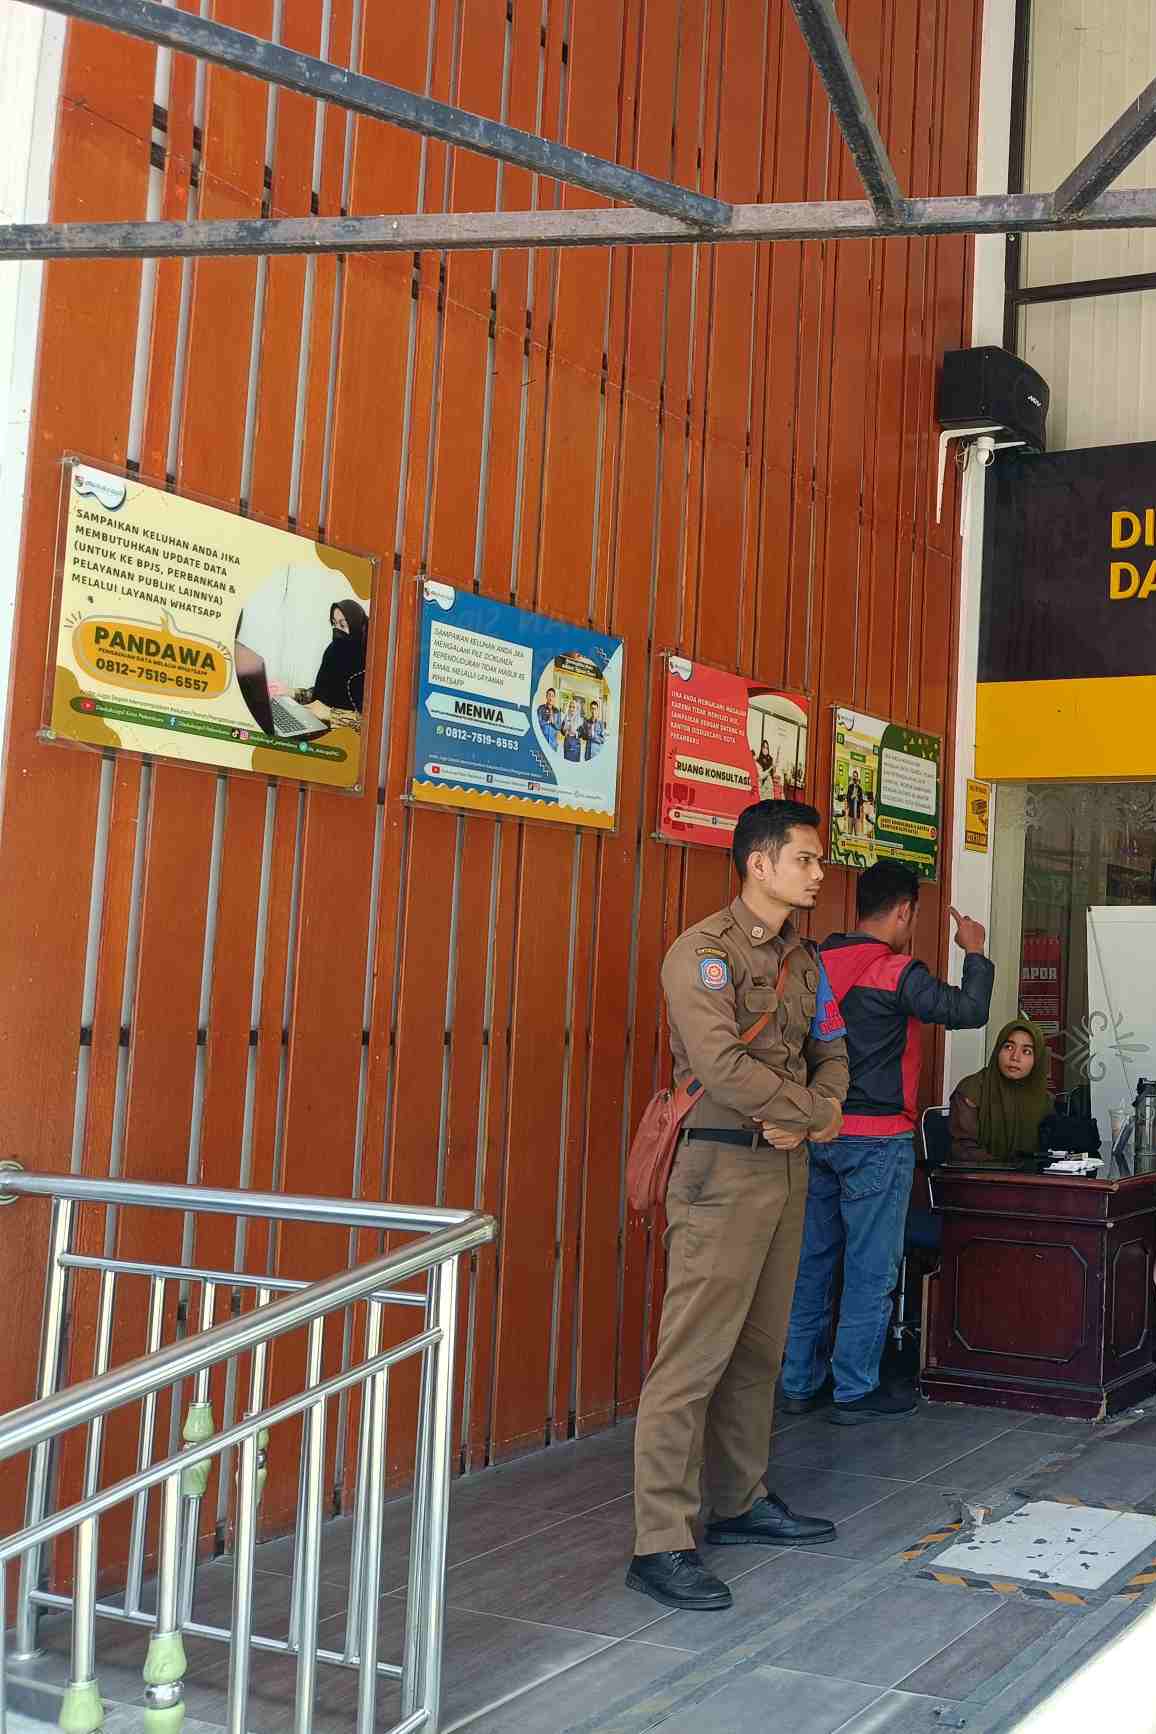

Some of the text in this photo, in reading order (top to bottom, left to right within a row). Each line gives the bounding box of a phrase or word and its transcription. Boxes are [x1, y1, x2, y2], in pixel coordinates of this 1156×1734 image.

[75, 525, 228, 577] MEMBUTUHKAN UPDATE DATA
[76, 508, 241, 566] SAMPAIKAN KELUHAN ANDA JIKA
[73, 557, 223, 606] PELAYANAN PUBLIK LAINNYA)
[74, 540, 236, 594] (UNTUK KE BPJS, PERBANKAN &
[71, 573, 222, 620] MELALUI LAYANAN WHATSAPP
[94, 626, 216, 672] PANDAWA
[96, 657, 209, 693] 0812-7519-6557
[454, 700, 505, 723] MENWA
[676, 761, 752, 786] RUANG KONSULTASI
